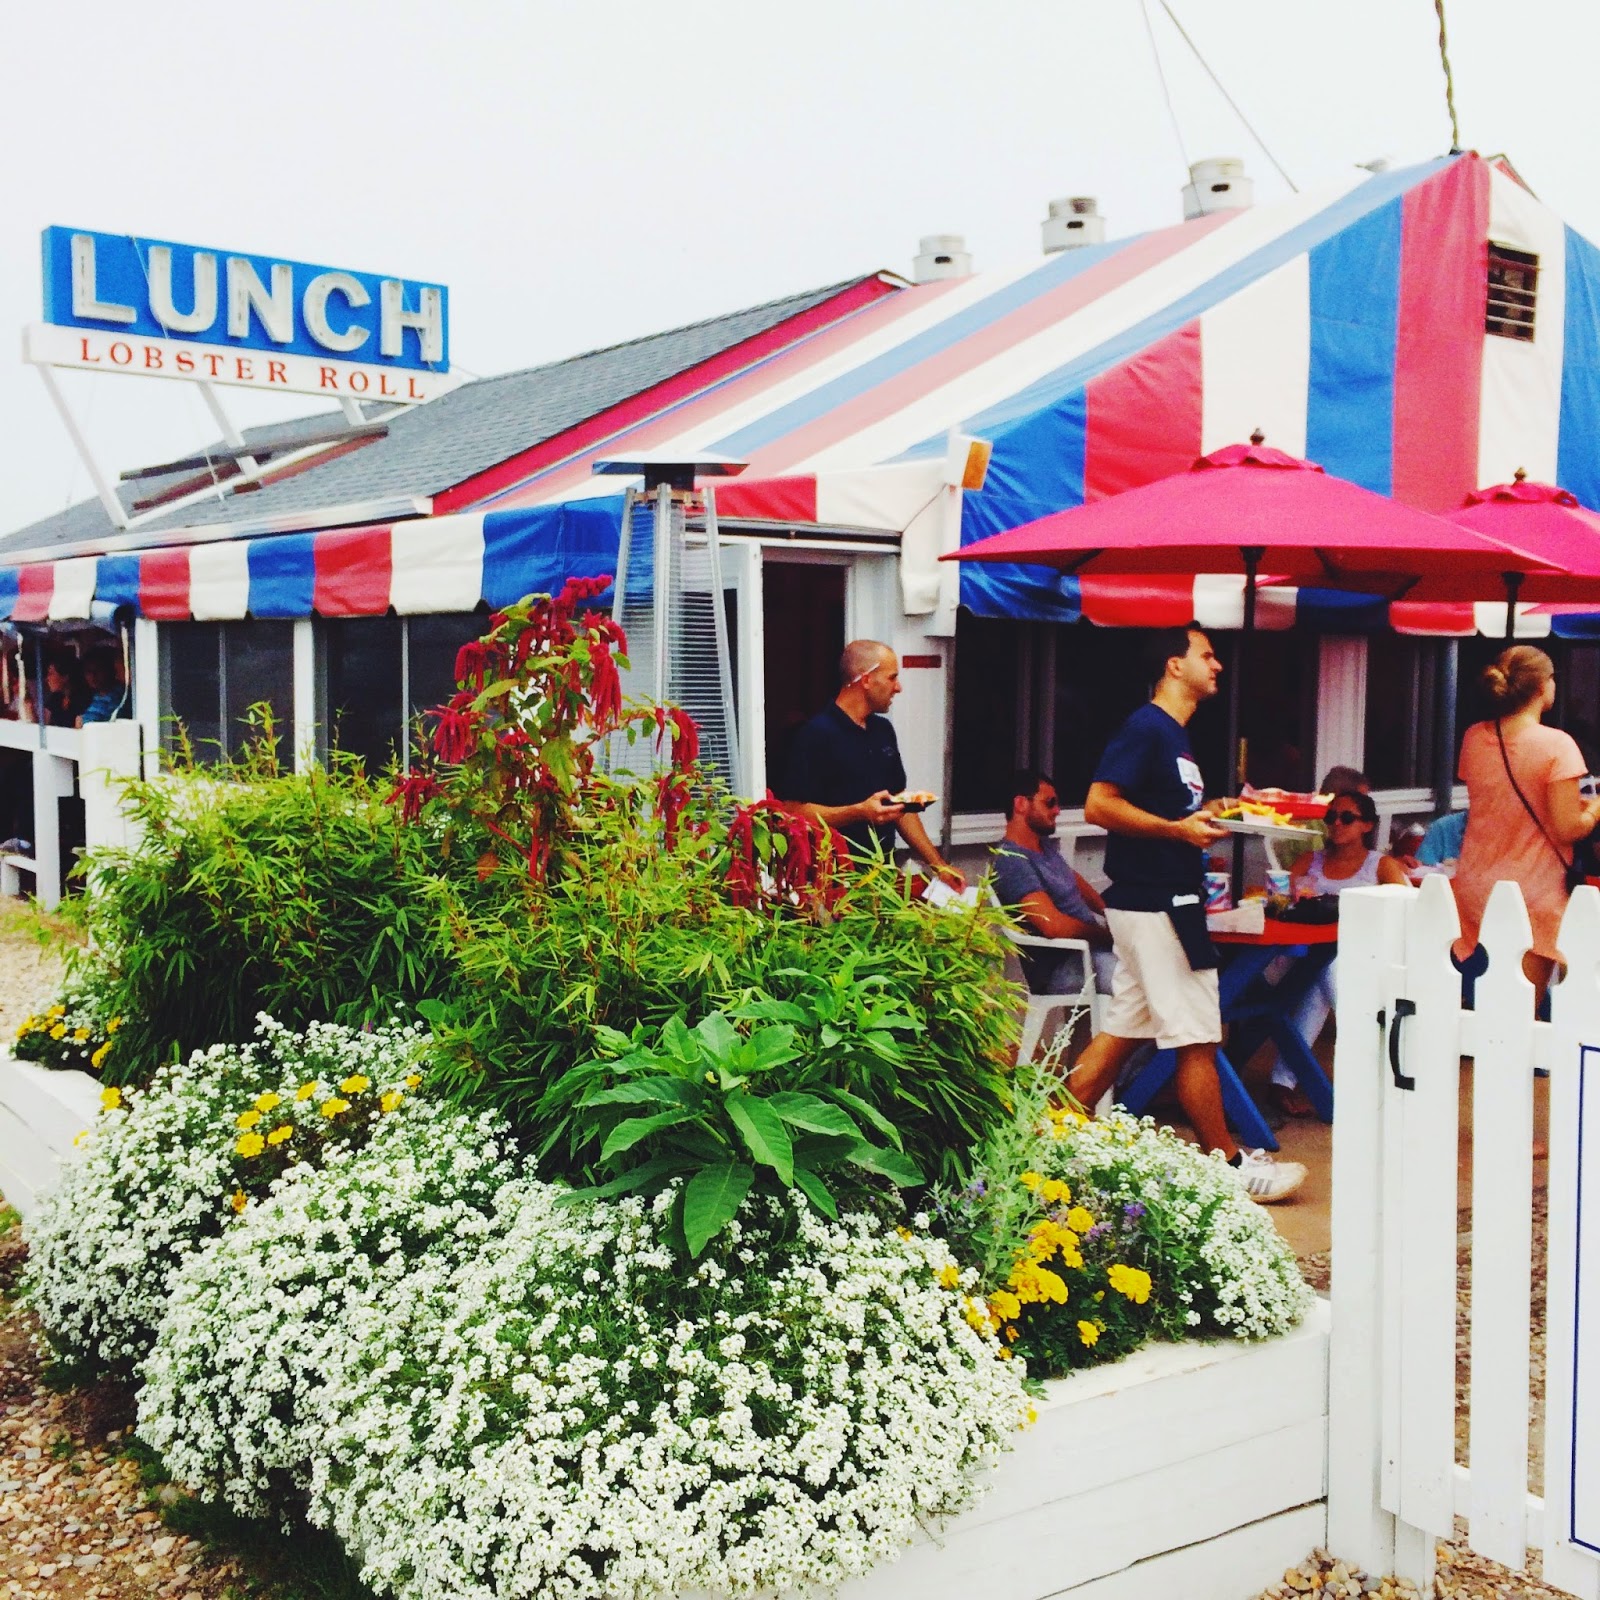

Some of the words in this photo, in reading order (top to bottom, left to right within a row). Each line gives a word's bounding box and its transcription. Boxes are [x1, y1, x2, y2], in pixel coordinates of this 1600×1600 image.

[71, 234, 443, 362] LUNCH
[80, 337, 288, 383] LOBSTER
[319, 366, 426, 400] ROLL
